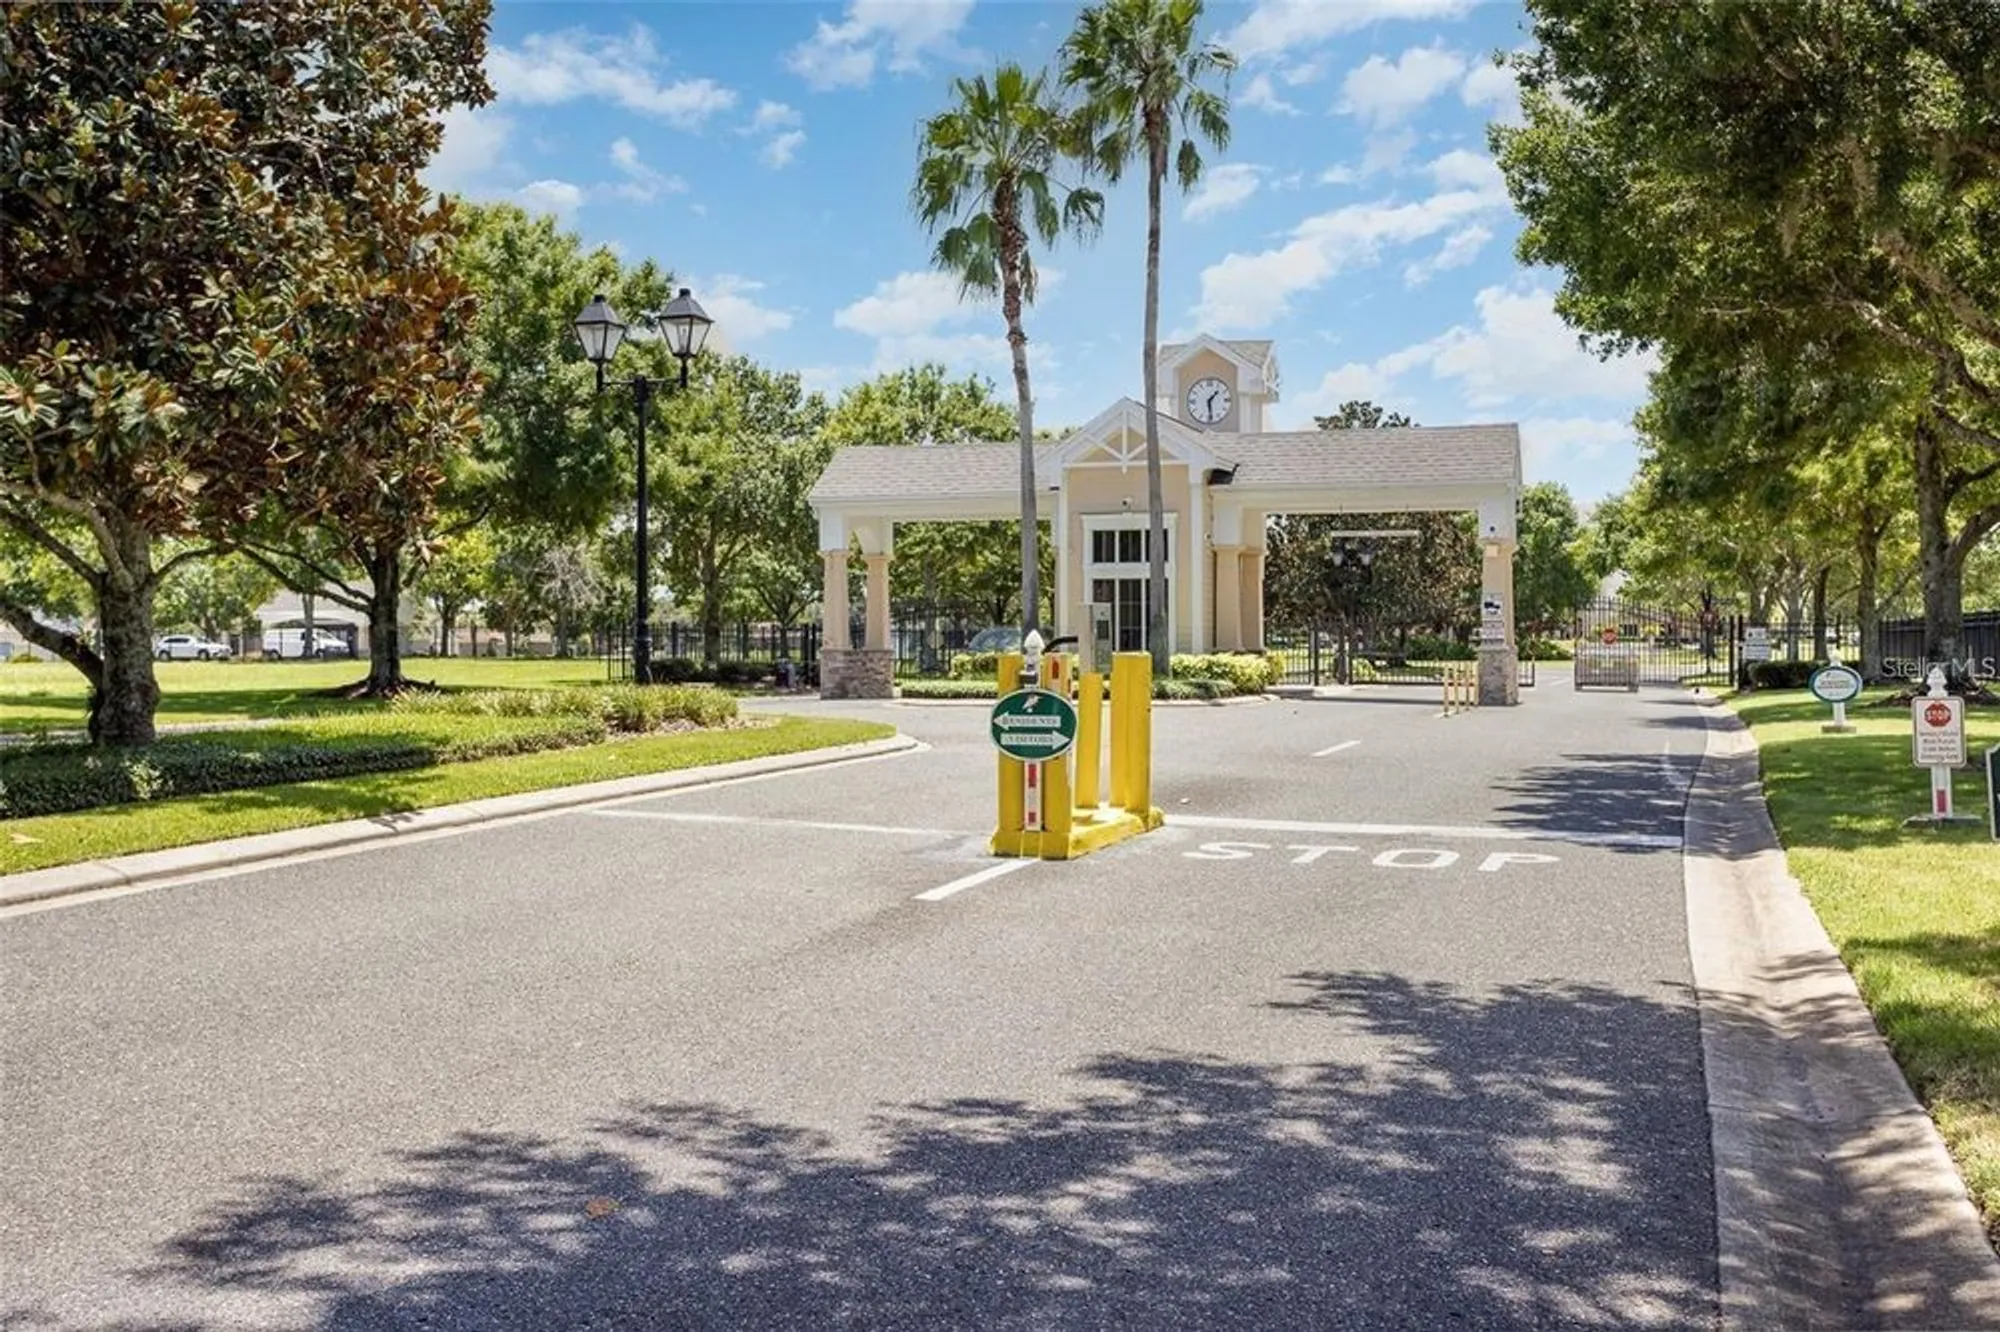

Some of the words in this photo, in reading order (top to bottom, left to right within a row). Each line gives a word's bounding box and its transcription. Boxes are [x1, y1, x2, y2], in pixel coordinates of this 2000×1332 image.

[1926, 709, 1952, 721] STOP
[1002, 716, 1058, 725] RESIDENTS
[1004, 734, 1054, 743] VISITORS
[1182, 841, 1561, 872] STOP
